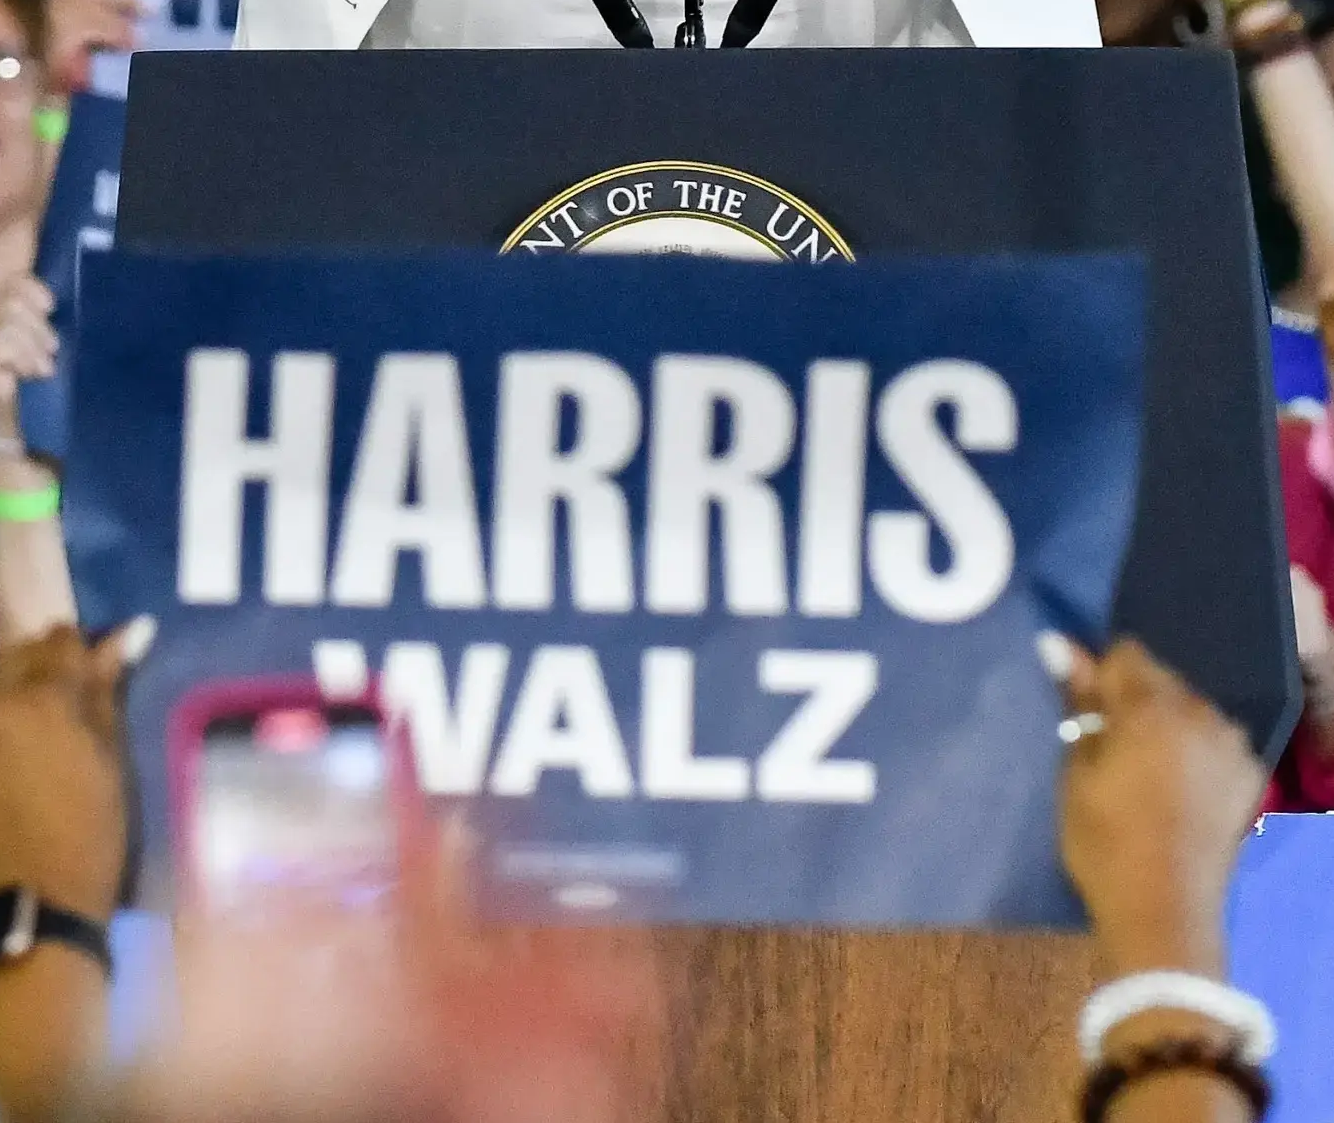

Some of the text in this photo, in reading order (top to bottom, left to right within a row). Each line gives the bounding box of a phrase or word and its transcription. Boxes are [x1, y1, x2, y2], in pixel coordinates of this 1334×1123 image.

[606, 181, 654, 217] OF
[672, 180, 748, 219] THE
[176, 347, 1019, 625] HARRIS
[311, 639, 879, 803] WALZ
